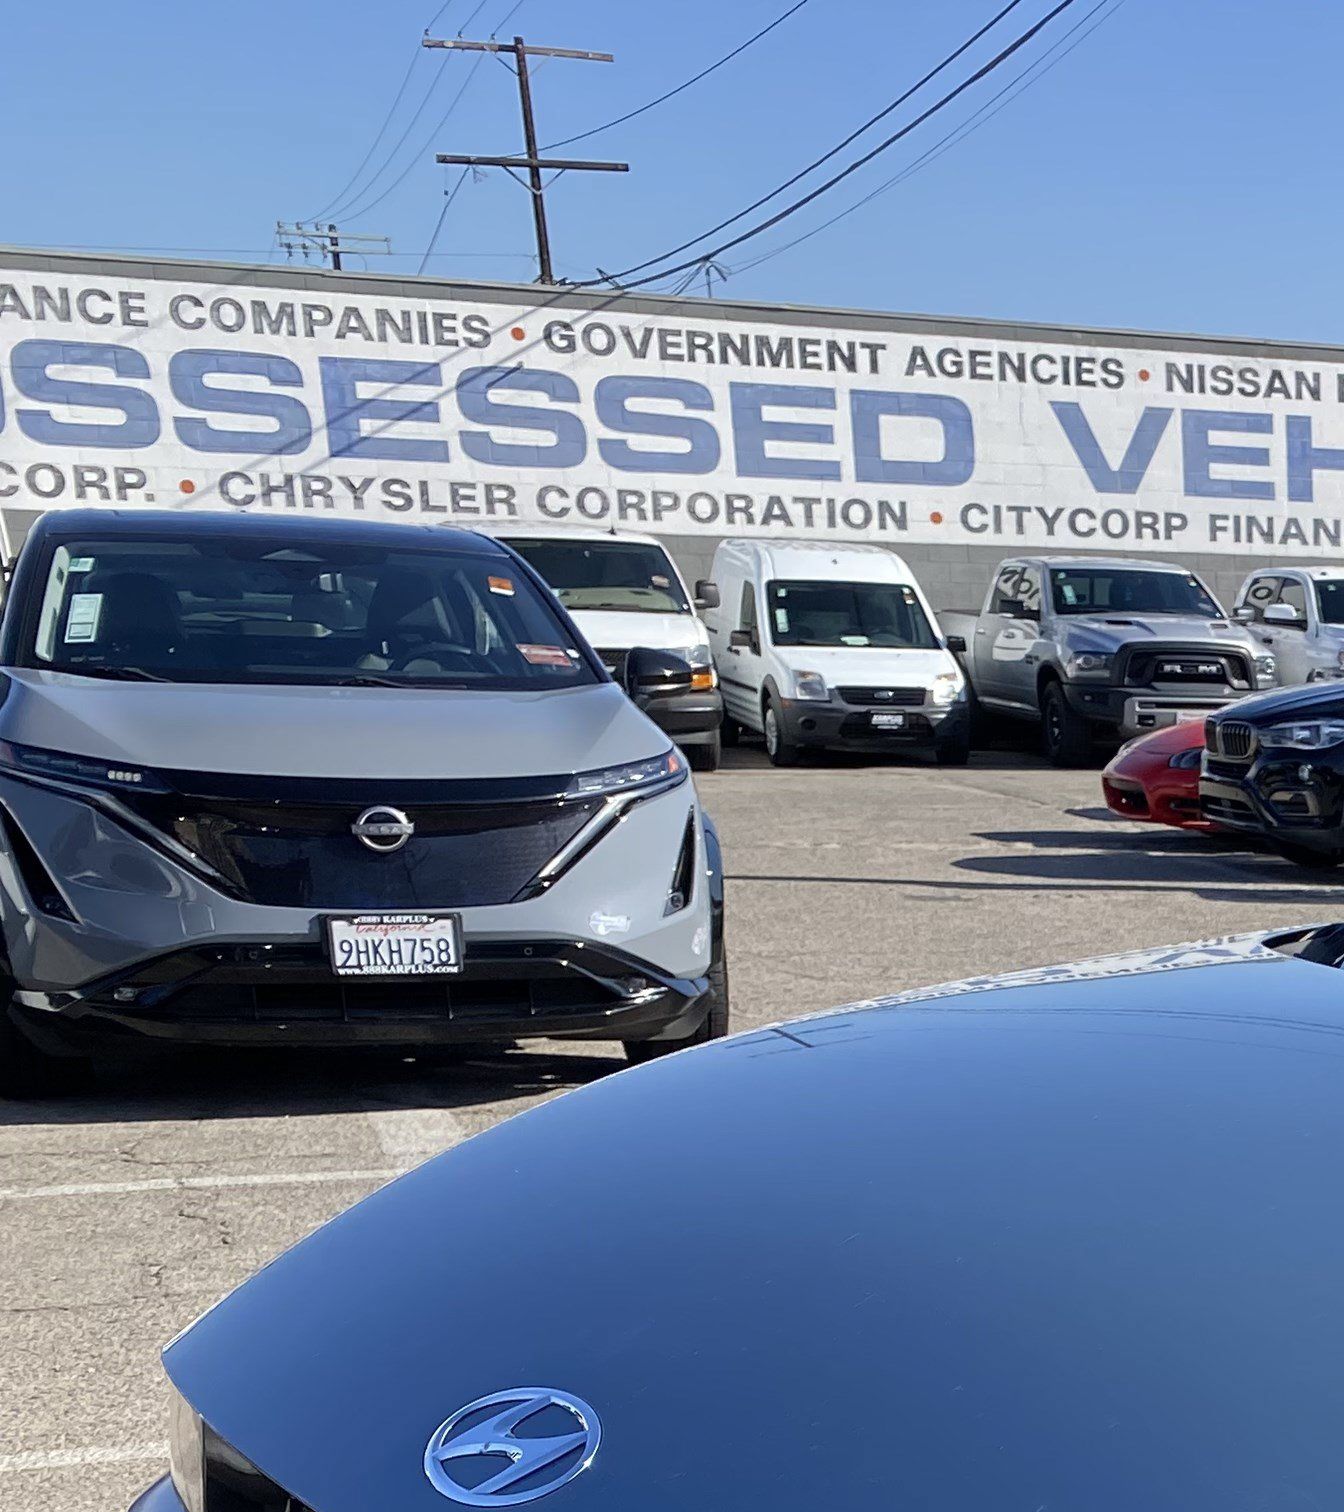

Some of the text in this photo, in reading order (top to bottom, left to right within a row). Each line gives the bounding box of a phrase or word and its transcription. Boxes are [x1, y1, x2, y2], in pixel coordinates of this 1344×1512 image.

[168, 293, 492, 348] COMPANIES
[543, 320, 887, 375] GOVERNMENT
[905, 346, 1125, 390] AGENCIES
[1165, 362, 1322, 402] NISSAN
[0, 338, 975, 487] SSESSED
[218, 470, 518, 516] CHRYSLER
[535, 485, 909, 531] CORPORATION
[959, 502, 1189, 541] CITYCORP
[338, 938, 452, 966] 9HKH758
[383, 915, 428, 923] KARPLUS
